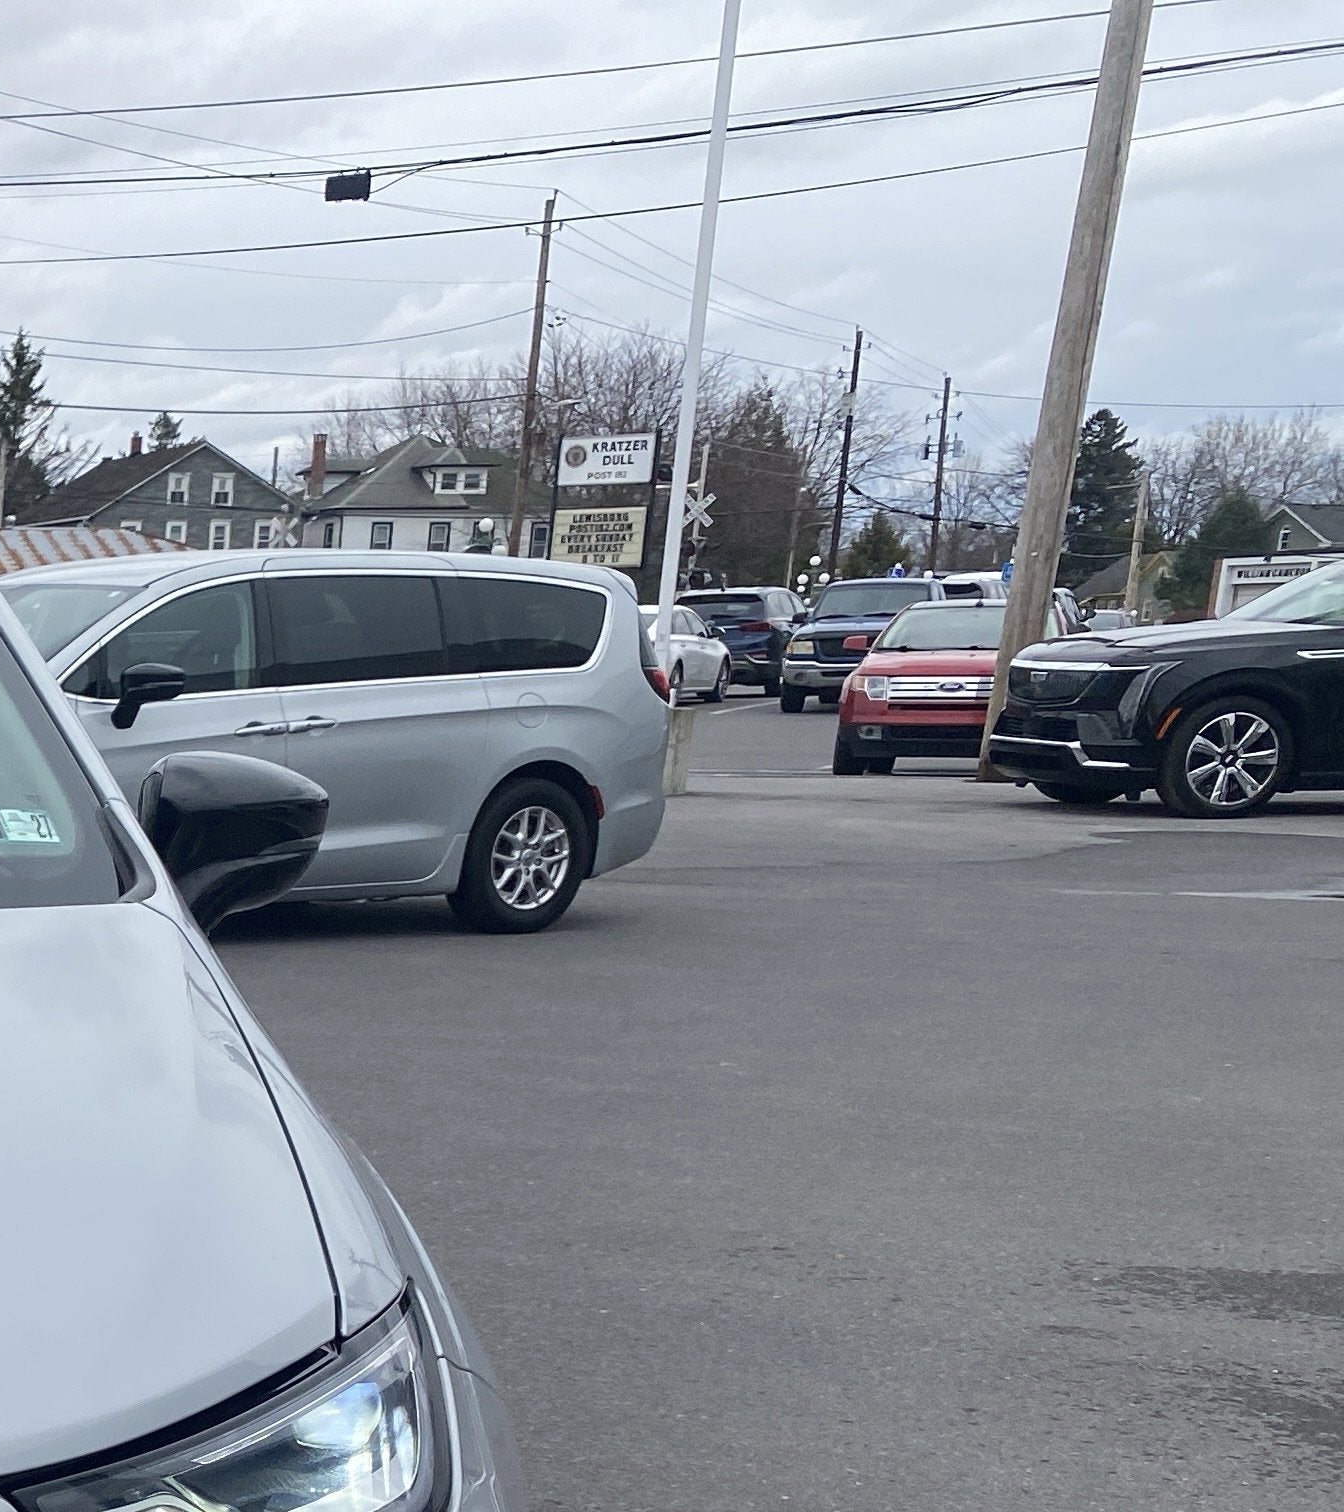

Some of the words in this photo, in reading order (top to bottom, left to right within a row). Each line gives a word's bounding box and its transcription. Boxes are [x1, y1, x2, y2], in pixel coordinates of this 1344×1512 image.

[591, 440, 649, 453] KRATZER
[602, 454, 634, 466] DULL
[586, 471, 612, 480] POST
[572, 512, 629, 523] LEWISBURG
[560, 534, 592, 543] EVERY
[567, 543, 625, 553] BREAKFAST
[593, 554, 605, 563] TO
